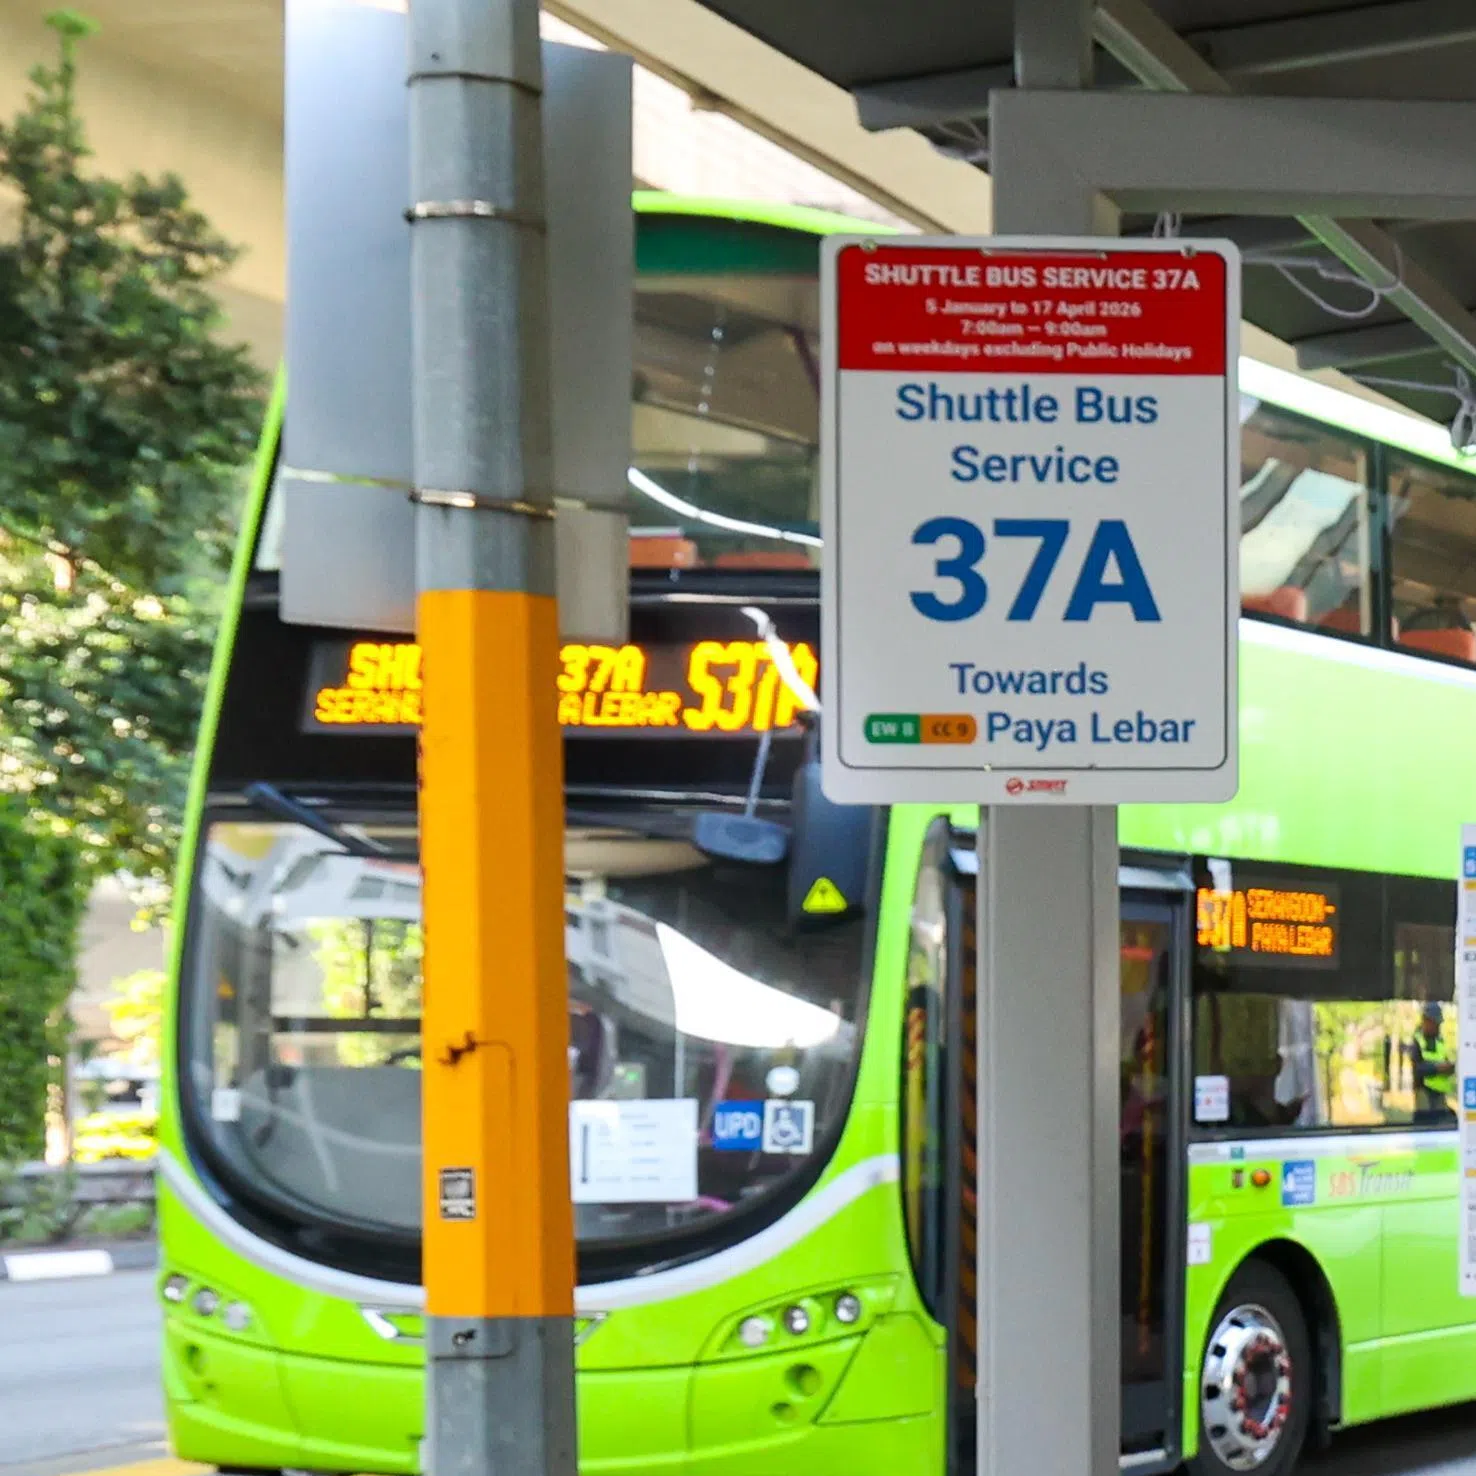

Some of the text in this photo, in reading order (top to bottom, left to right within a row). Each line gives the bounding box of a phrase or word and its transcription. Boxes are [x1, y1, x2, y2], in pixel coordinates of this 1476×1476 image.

[864, 262, 1201, 291] SHUTTLE BUS SERVICE 37A
[940, 298, 1008, 319] January
[1010, 300, 1029, 316] to
[1032, 300, 1053, 316] 17
[1055, 301, 1097, 319] April
[1098, 301, 1143, 318] 2026
[960, 318, 1025, 337] 7:00am
[1044, 320, 1109, 338] 9:00am
[896, 339, 981, 360] weekdays
[982, 340, 1064, 362] excluding
[1066, 341, 1119, 359] Public
[1120, 342, 1193, 363] Holidays
[895, 382, 1159, 425] Shuttle Bus
[950, 444, 1121, 485] Service
[908, 515, 1163, 623] 37A
[557, 644, 646, 692] 37A
[948, 661, 1110, 695] Towards
[871, 720, 899, 738] EW
[986, 710, 1196, 751] Paya Lebar
